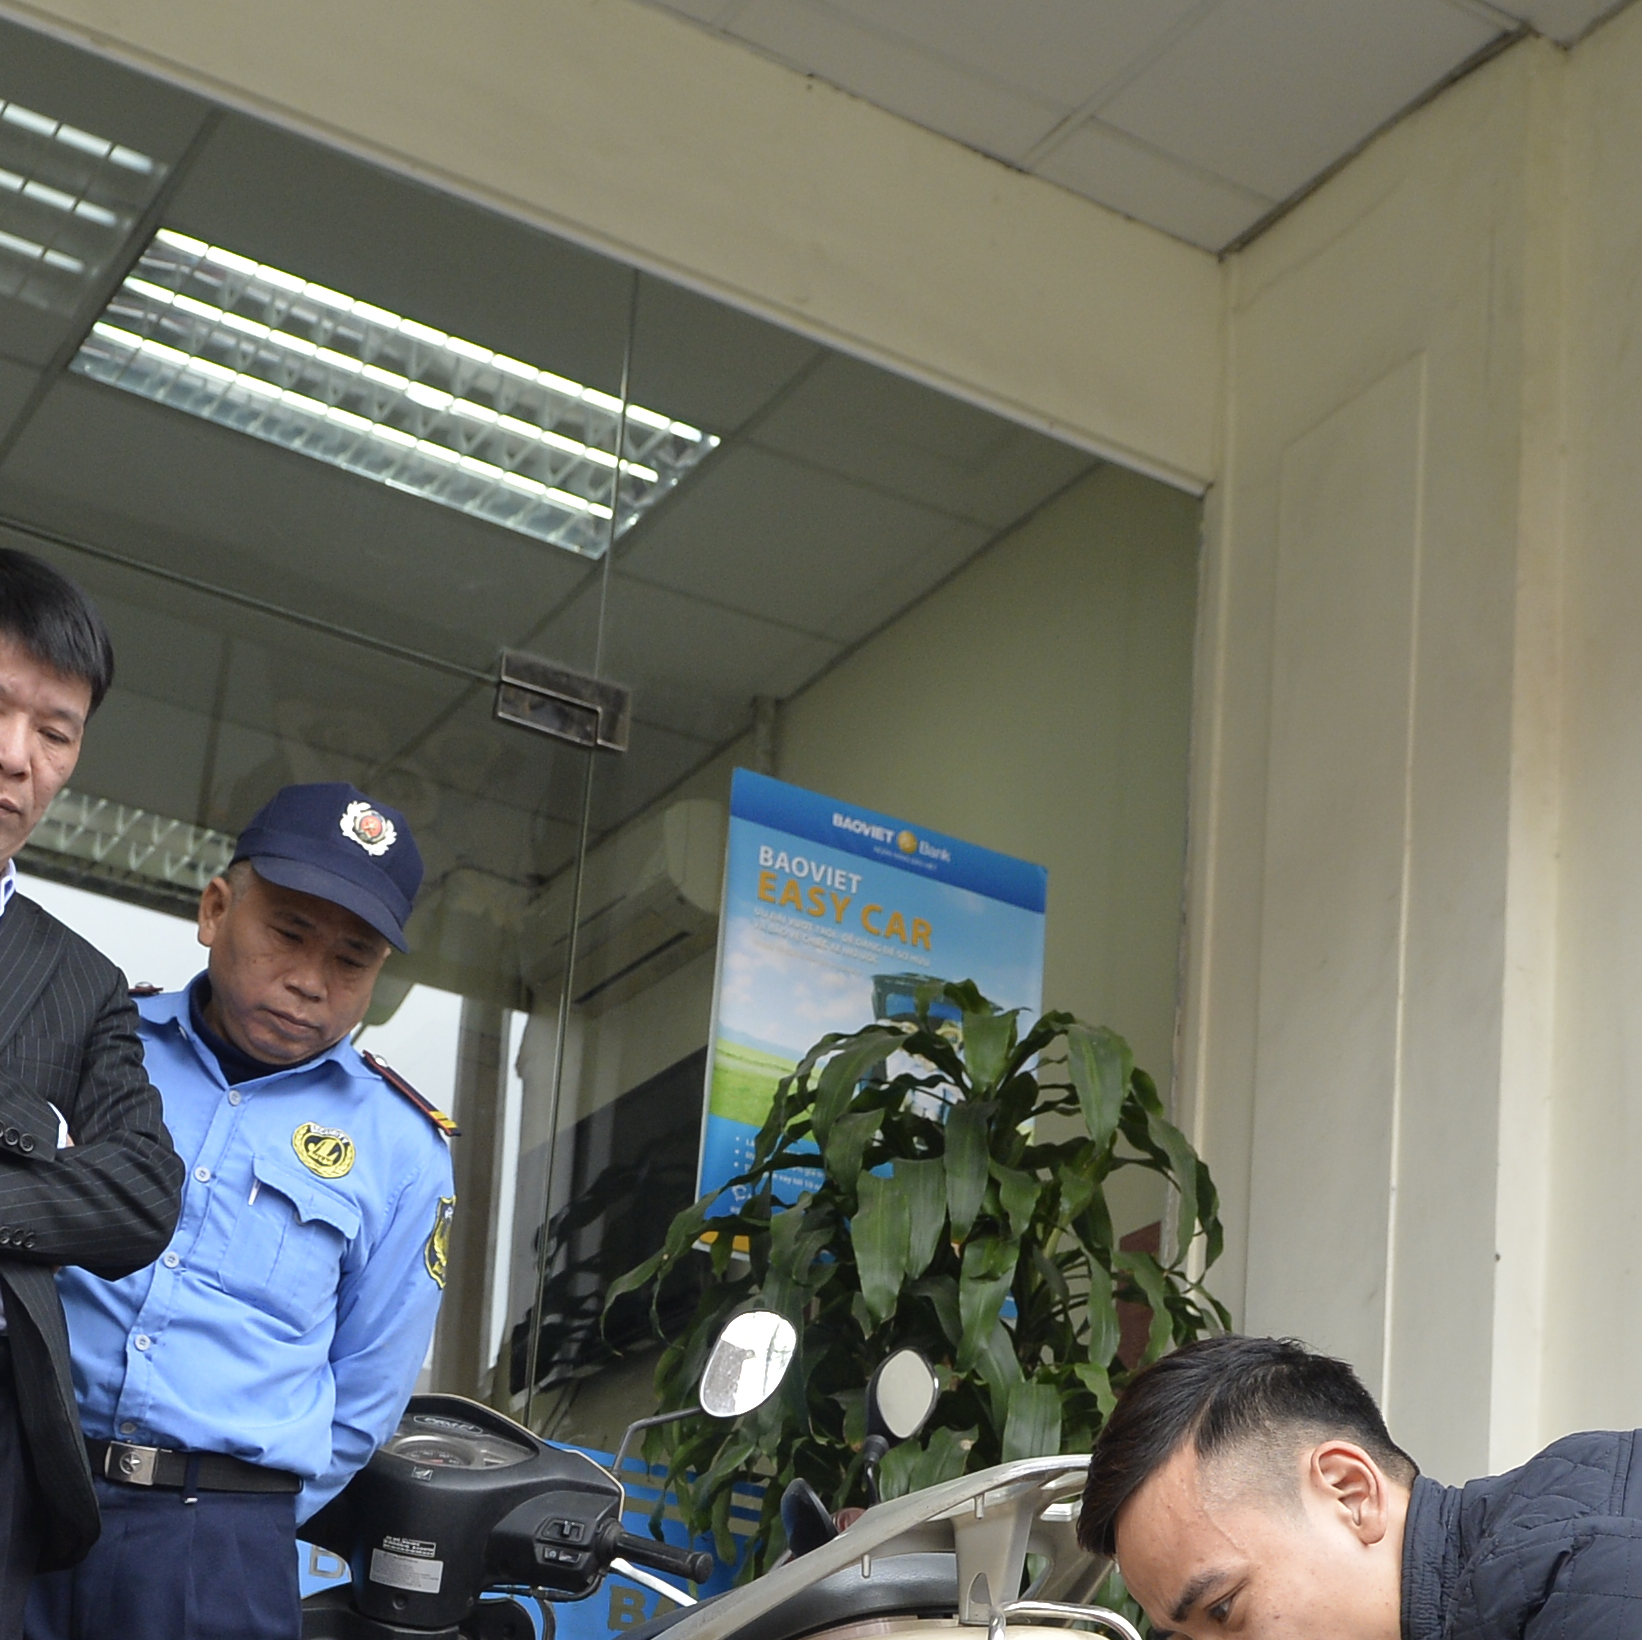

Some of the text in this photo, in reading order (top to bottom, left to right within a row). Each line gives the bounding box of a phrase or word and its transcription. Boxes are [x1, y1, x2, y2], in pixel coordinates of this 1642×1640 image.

[832, 812, 895, 844] BAOVIET
[759, 845, 863, 895] BAOVIET
[758, 871, 852, 925] EASY
[860, 903, 933, 952] CAR
